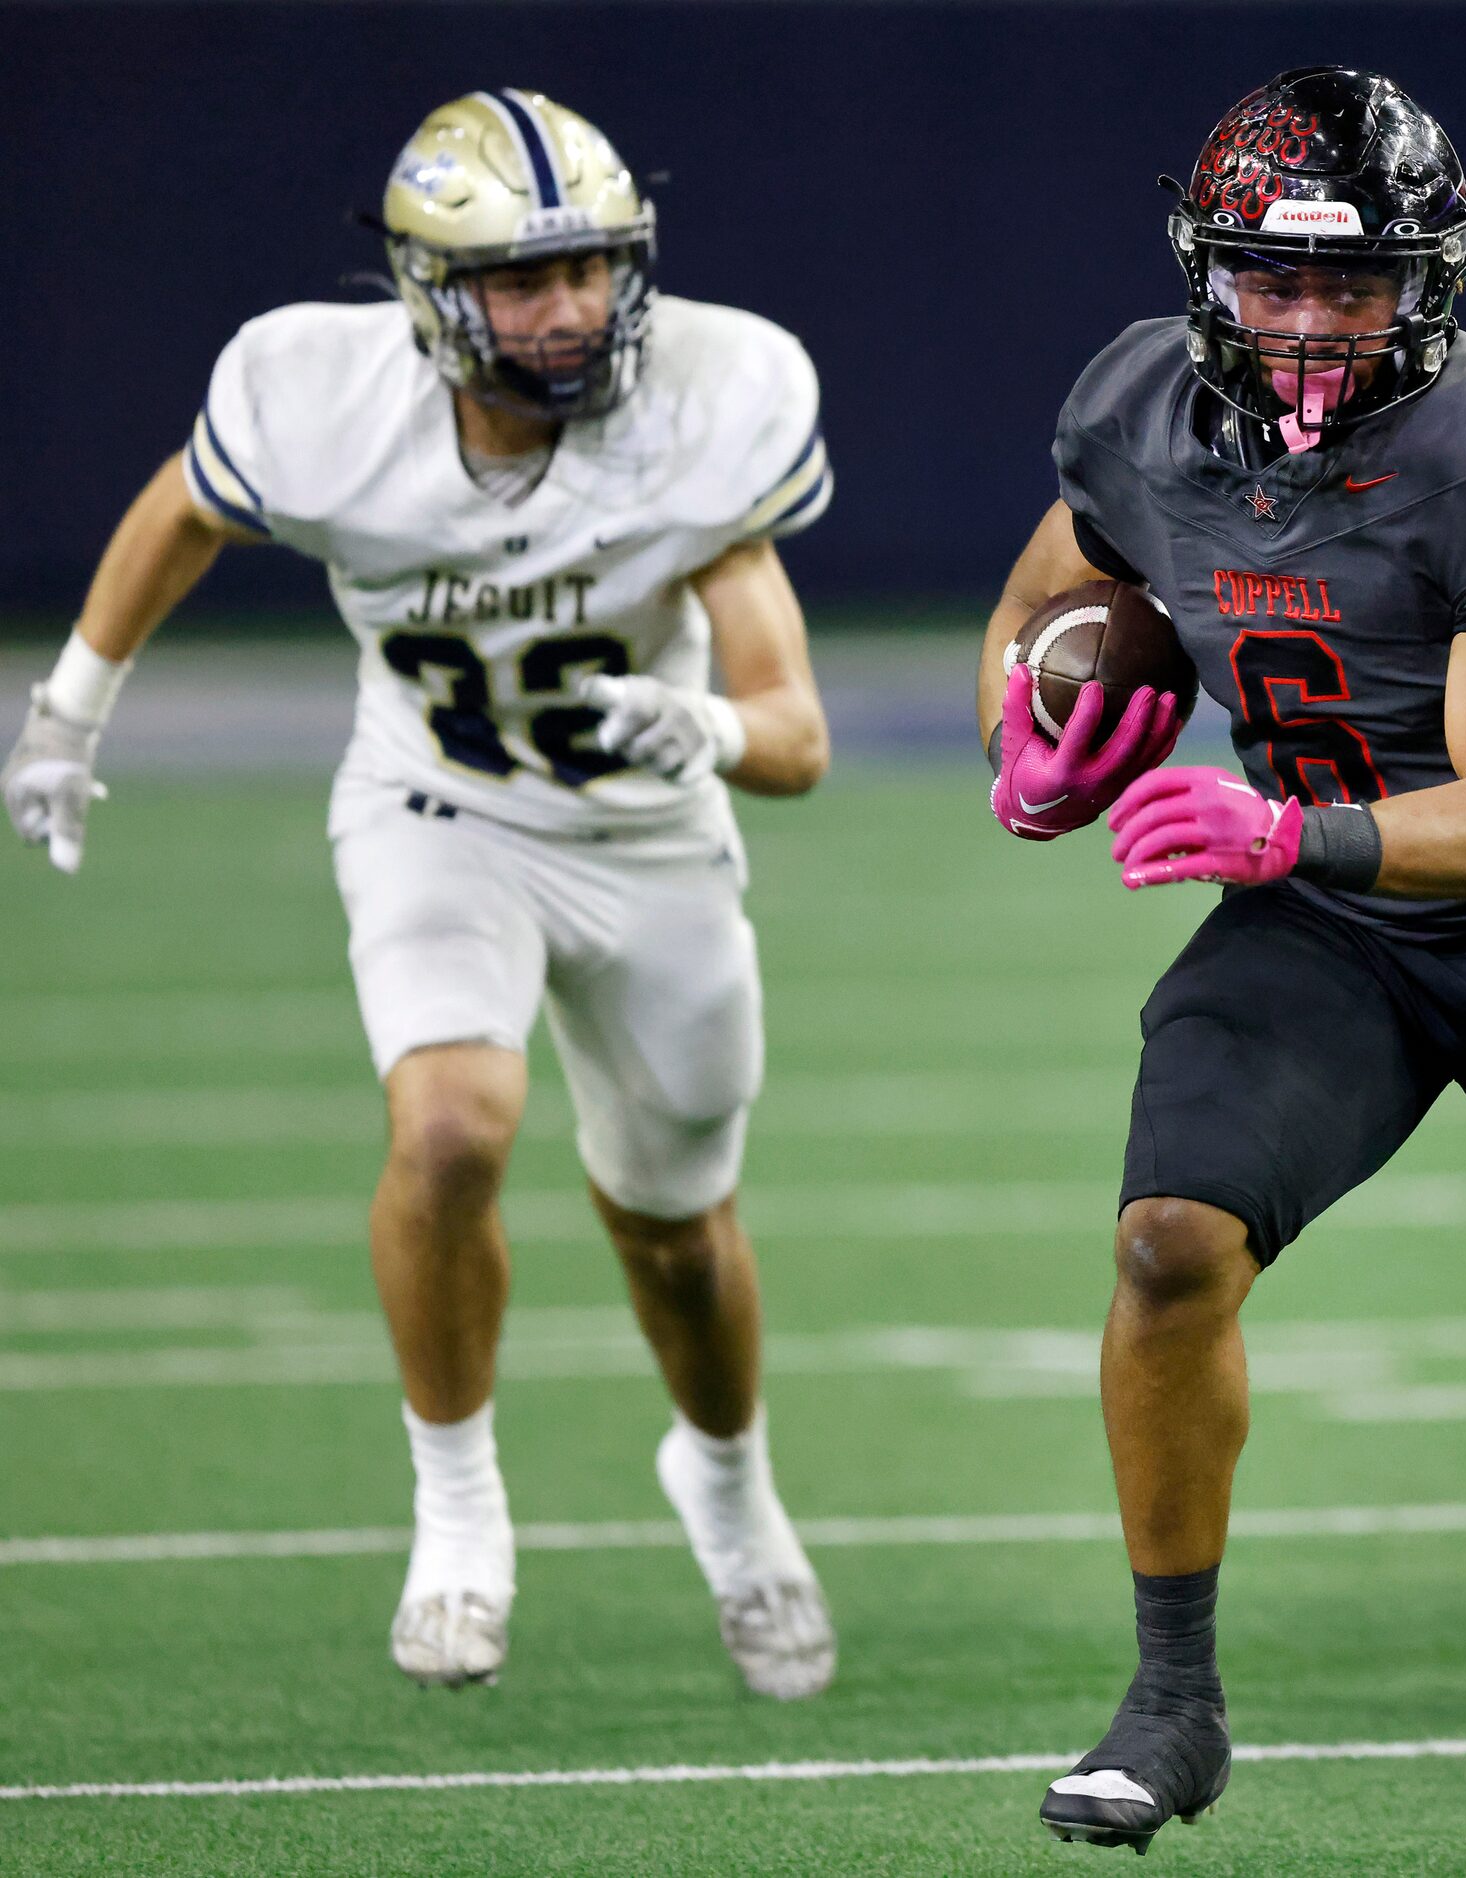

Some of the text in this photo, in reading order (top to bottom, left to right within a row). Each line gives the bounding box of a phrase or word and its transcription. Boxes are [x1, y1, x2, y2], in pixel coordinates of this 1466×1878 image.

[1213, 569, 1342, 623] COPPELL
[378, 630, 637, 790] 32
[1229, 629, 1389, 808] 6
